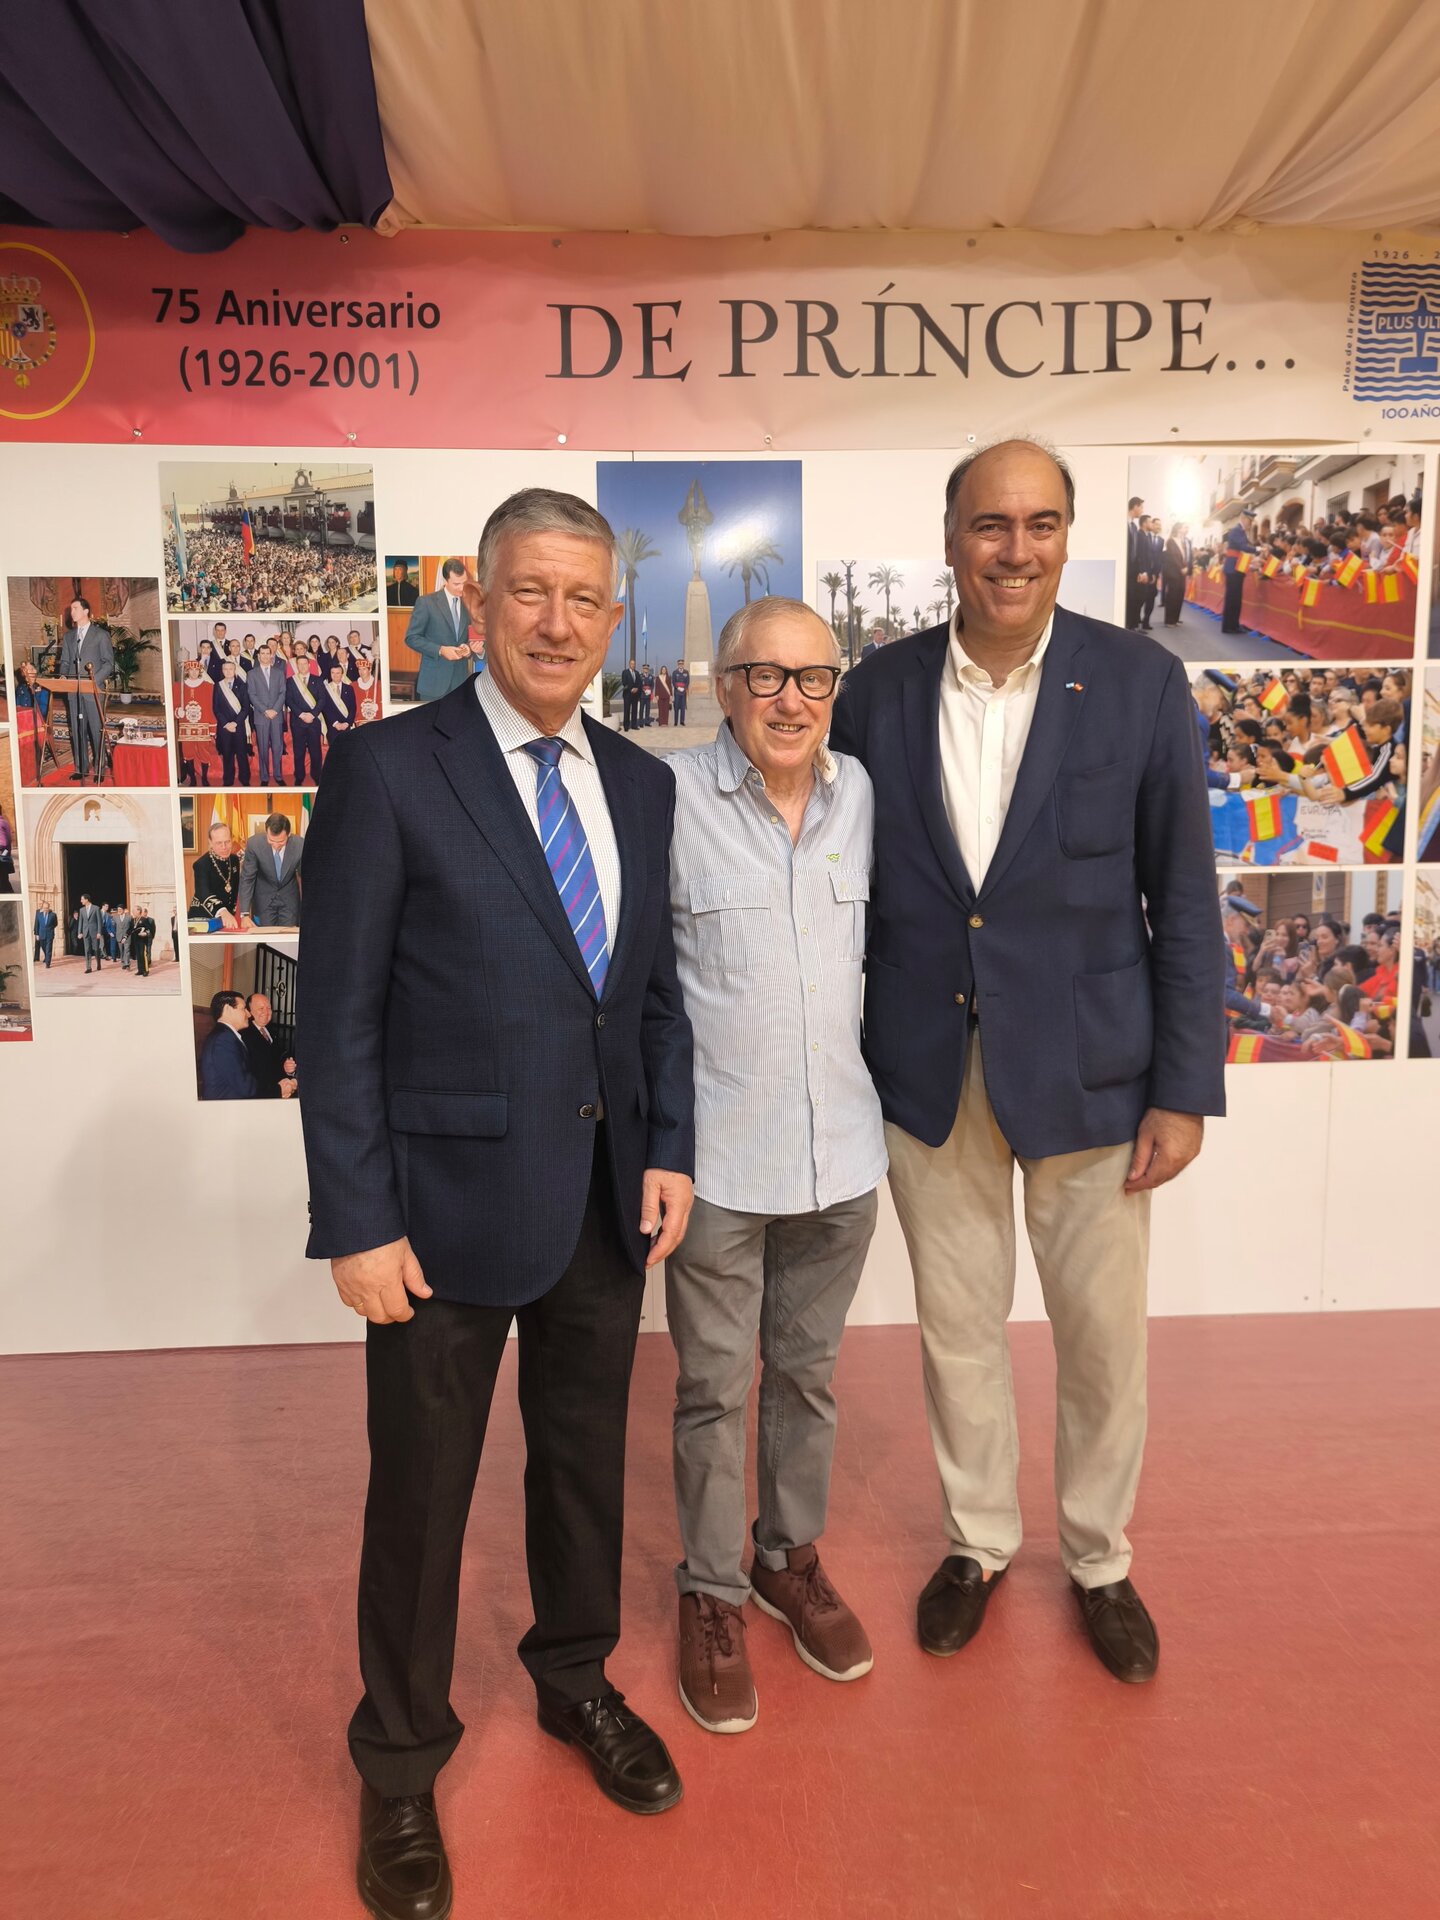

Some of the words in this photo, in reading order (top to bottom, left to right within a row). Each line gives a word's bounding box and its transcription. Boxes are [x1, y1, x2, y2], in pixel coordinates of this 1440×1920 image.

[1374, 250, 1409, 260] 1926
[152, 288, 200, 323] 75
[215, 288, 440, 329] Aniversario
[1347, 272, 1357, 324] Frontera
[545, 300, 693, 382] DE
[717, 282, 1297, 379] PRÍNCIPE...
[1346, 328, 1353, 338] la
[1378, 316, 1414, 330] PLUS
[1345, 342, 1352, 356] de
[179, 346, 420, 396] (1926-2001)
[1342, 360, 1351, 392] Palos
[1382, 408, 1409, 419] 100
